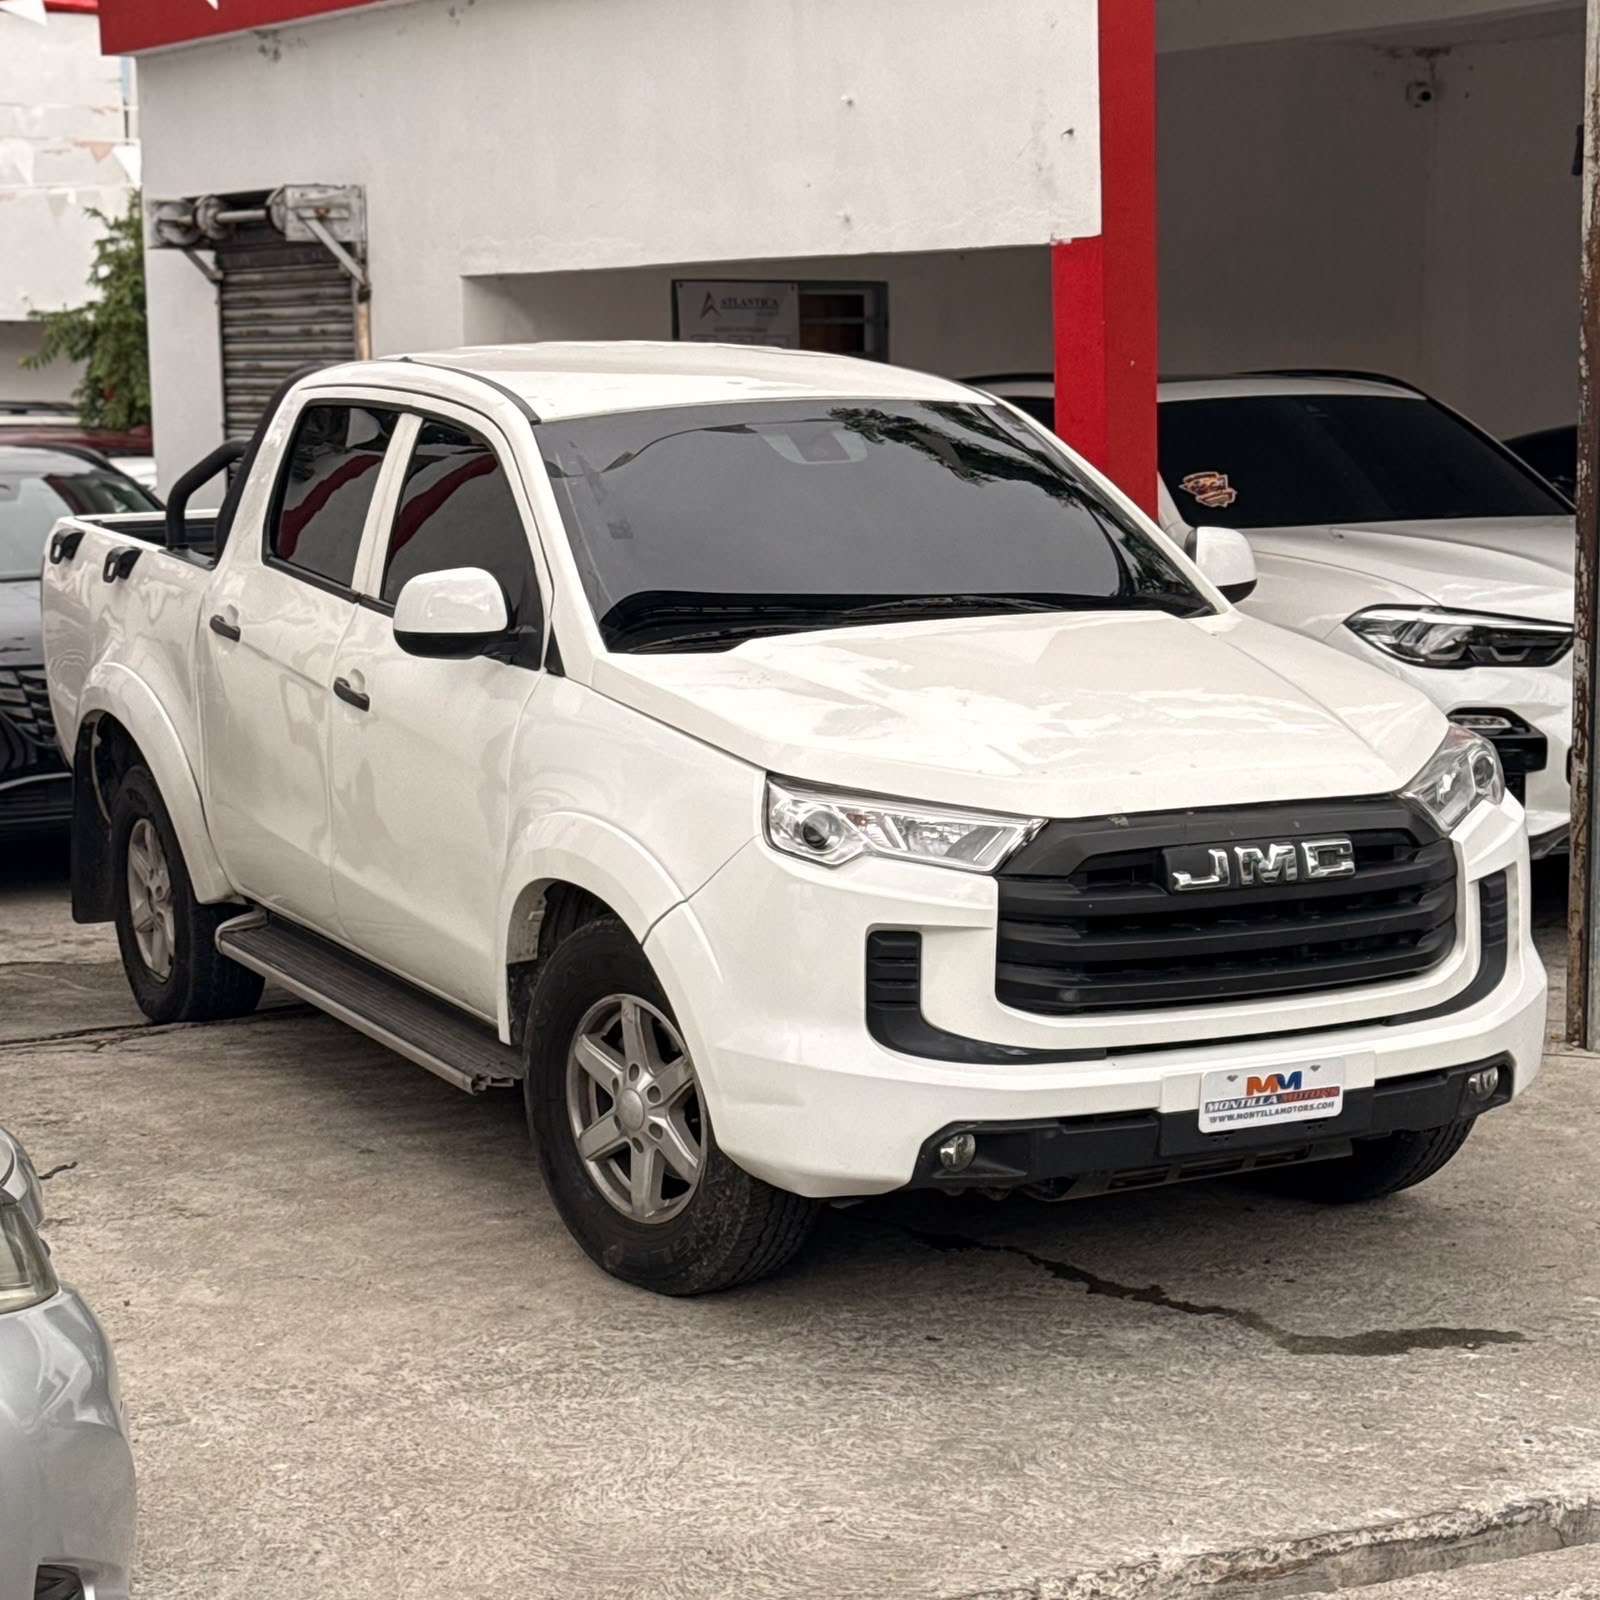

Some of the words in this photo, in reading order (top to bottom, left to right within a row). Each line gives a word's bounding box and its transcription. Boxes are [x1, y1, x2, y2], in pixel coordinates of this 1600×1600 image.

[1172, 838, 1356, 891] JMC
[1246, 1071, 1302, 1096] MM
[1209, 1102, 1335, 1123] WWW.MONTILLAMOTORS.COM
